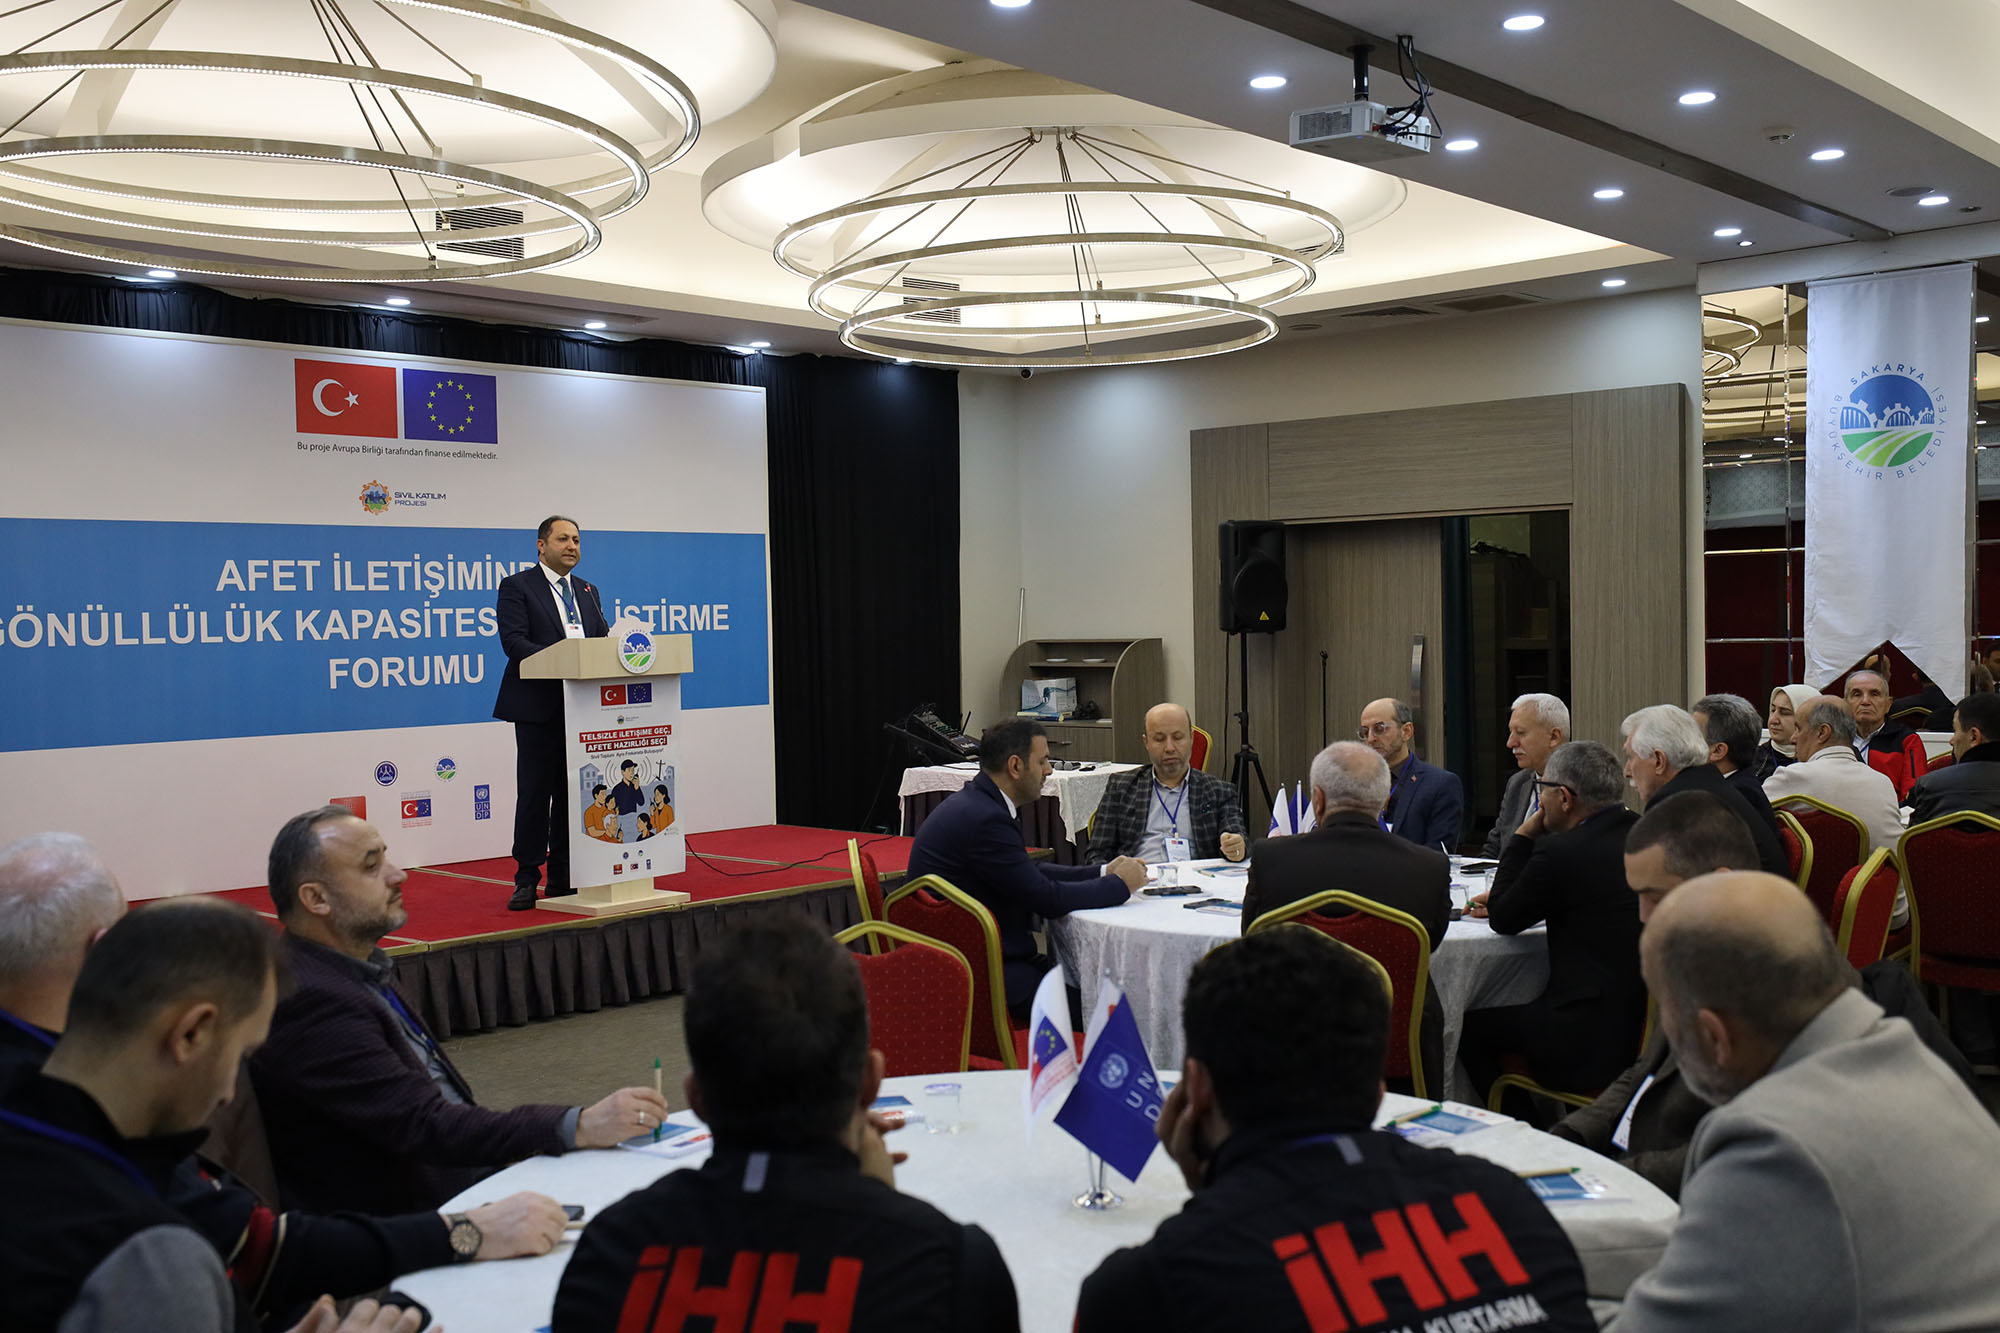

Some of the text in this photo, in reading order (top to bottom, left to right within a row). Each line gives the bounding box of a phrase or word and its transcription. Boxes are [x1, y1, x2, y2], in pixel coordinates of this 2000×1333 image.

[1850, 363, 1925, 385] SAKARYA
[297, 441, 498, 460] Bu proje Avrupa Birliği tarafından finanse edilmektedir.
[215, 559, 321, 592] AFET
[0, 602, 284, 648] ÖNÜLLÜLÜK
[295, 600, 499, 641] KAPASİTES
[329, 653, 484, 689] FORUMU
[588, 743, 612, 751] AFETE
[614, 738, 648, 749] HAZIRLIĞI
[1126, 1070, 1155, 1108] UN
[1423, 1294, 1549, 1333] KURTARMA
